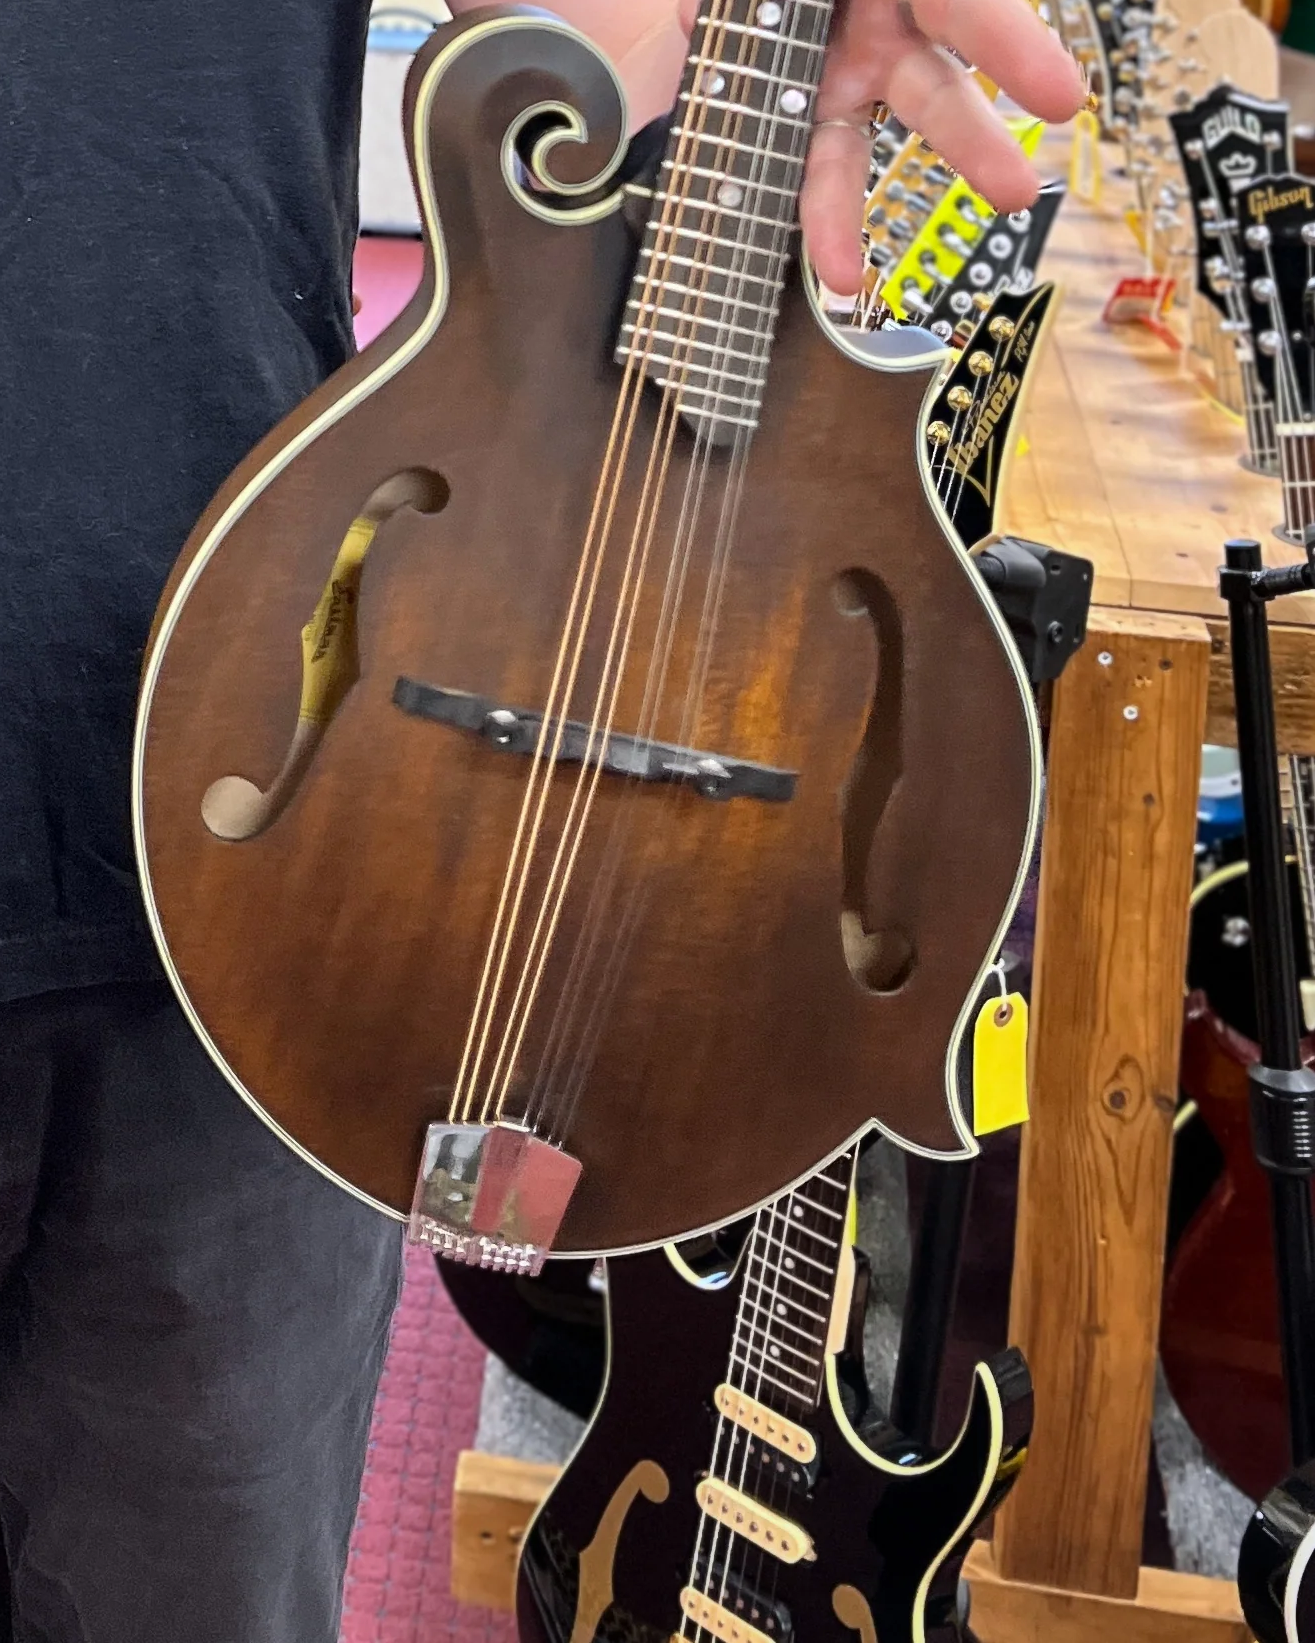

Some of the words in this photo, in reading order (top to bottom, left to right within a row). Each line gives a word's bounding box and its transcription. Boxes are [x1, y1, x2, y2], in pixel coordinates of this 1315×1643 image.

[1201, 105, 1263, 150] GUILD
[1248, 186, 1314, 224] Gibson
[947, 371, 1020, 476] Ibanez
